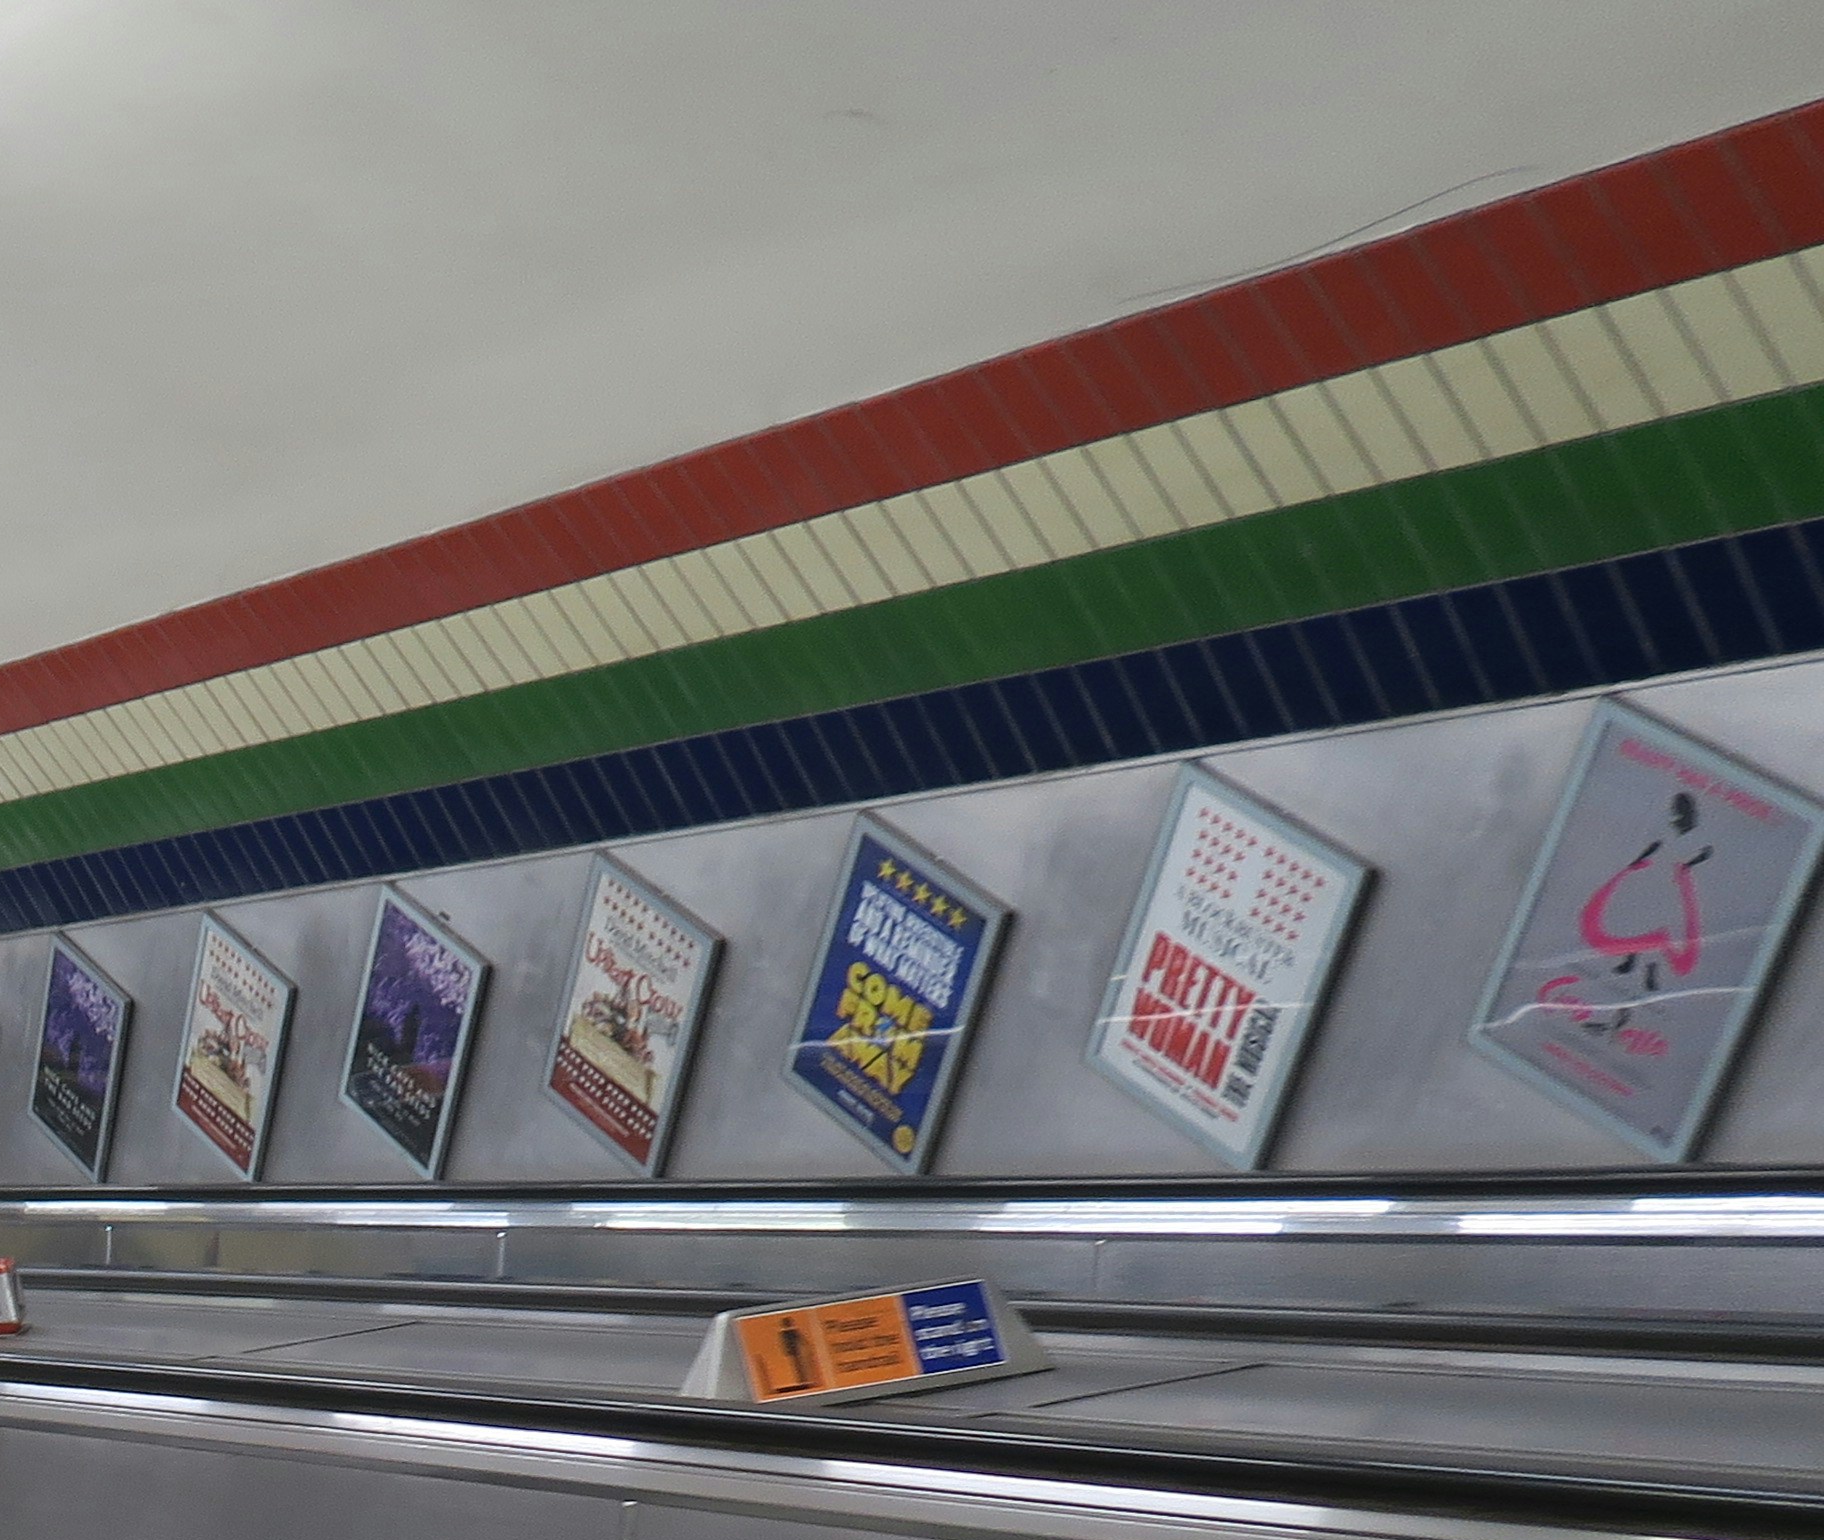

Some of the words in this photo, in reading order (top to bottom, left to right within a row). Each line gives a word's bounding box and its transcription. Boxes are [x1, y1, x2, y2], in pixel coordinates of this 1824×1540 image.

[847, 961, 934, 1032] COME
[1142, 930, 1258, 1040] PRETTY
[827, 1022, 915, 1096] AWAY
[1128, 986, 1232, 1090] WOMAN
